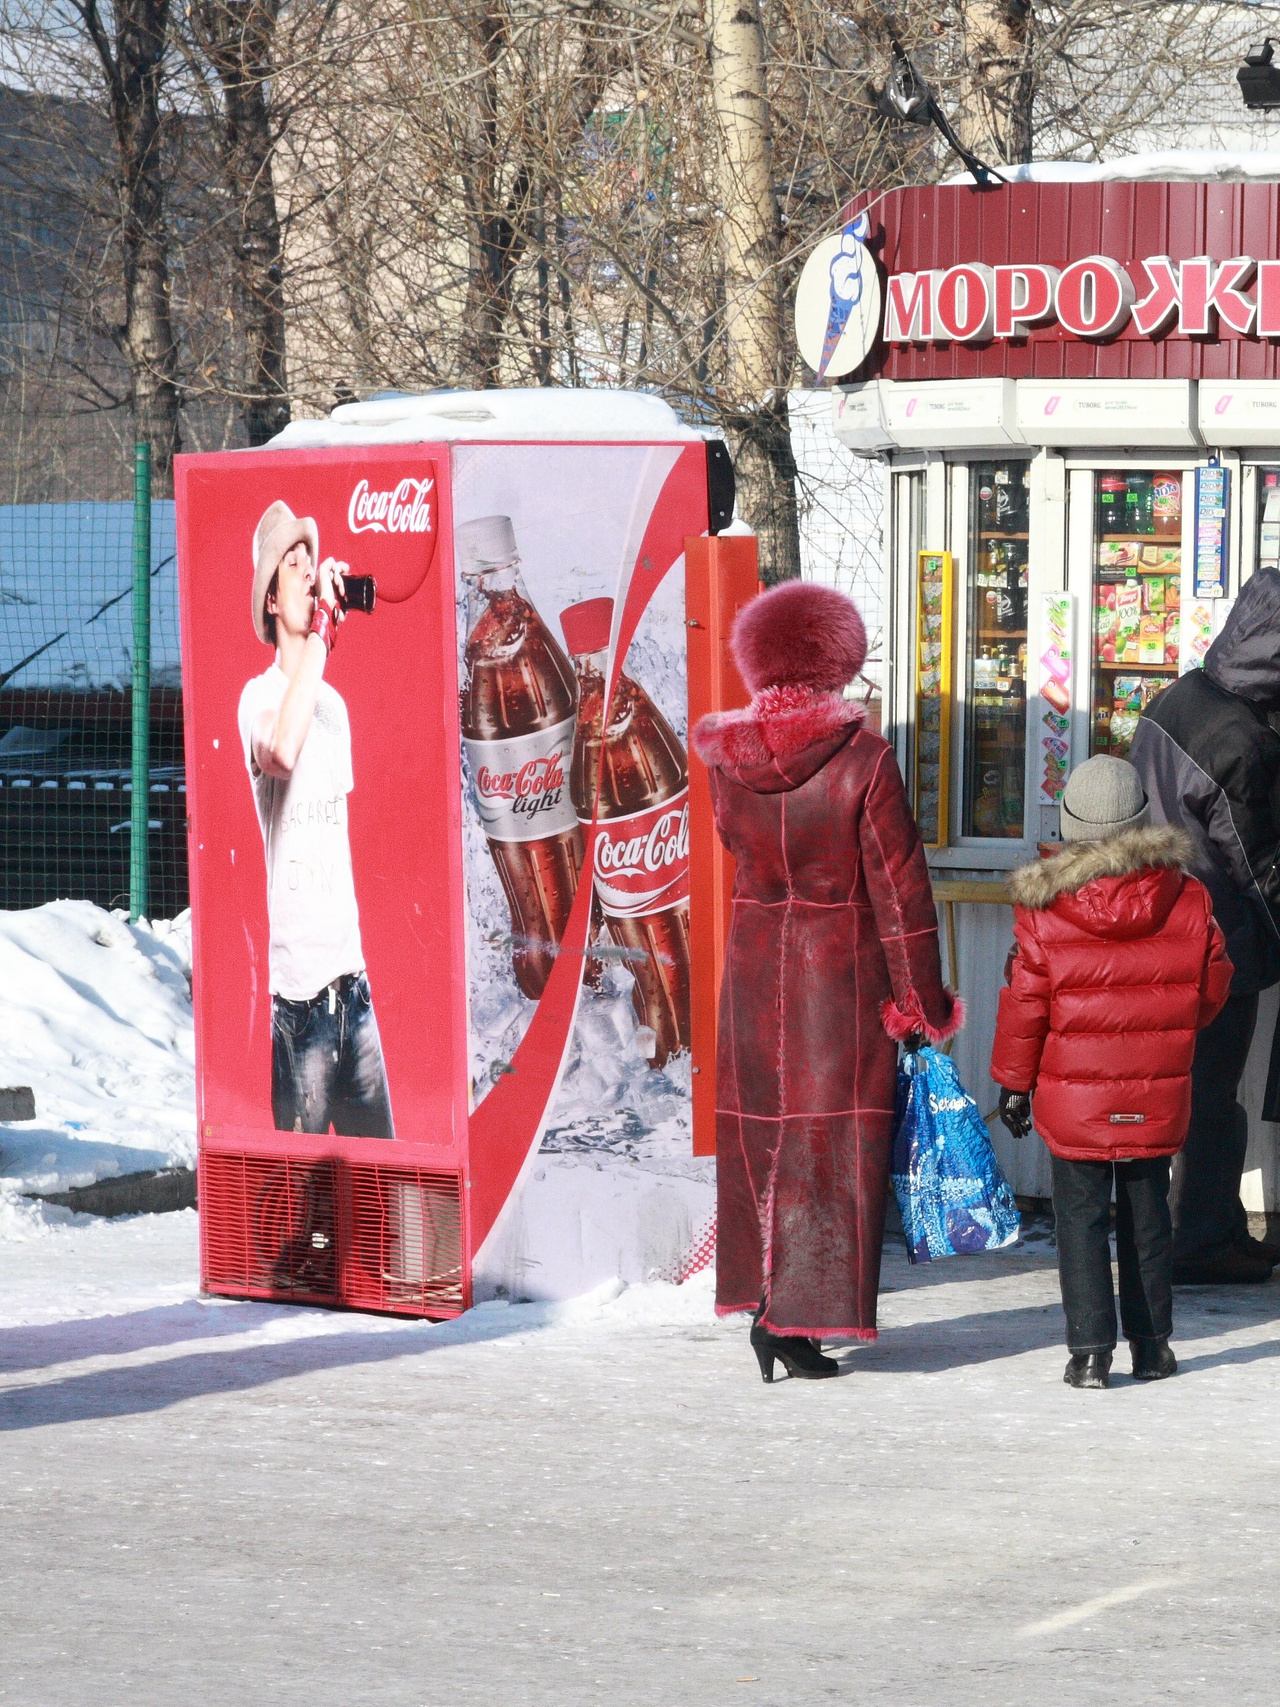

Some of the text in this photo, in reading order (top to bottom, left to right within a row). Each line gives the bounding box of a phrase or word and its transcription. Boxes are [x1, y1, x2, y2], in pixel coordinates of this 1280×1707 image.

[1078, 401, 1101, 409] TUBORG
[348, 477, 434, 534] Coca-Cola
[477, 751, 564, 800] Coca-Cola
[510, 787, 563, 819] light
[594, 801, 689, 878] Coca-Col
